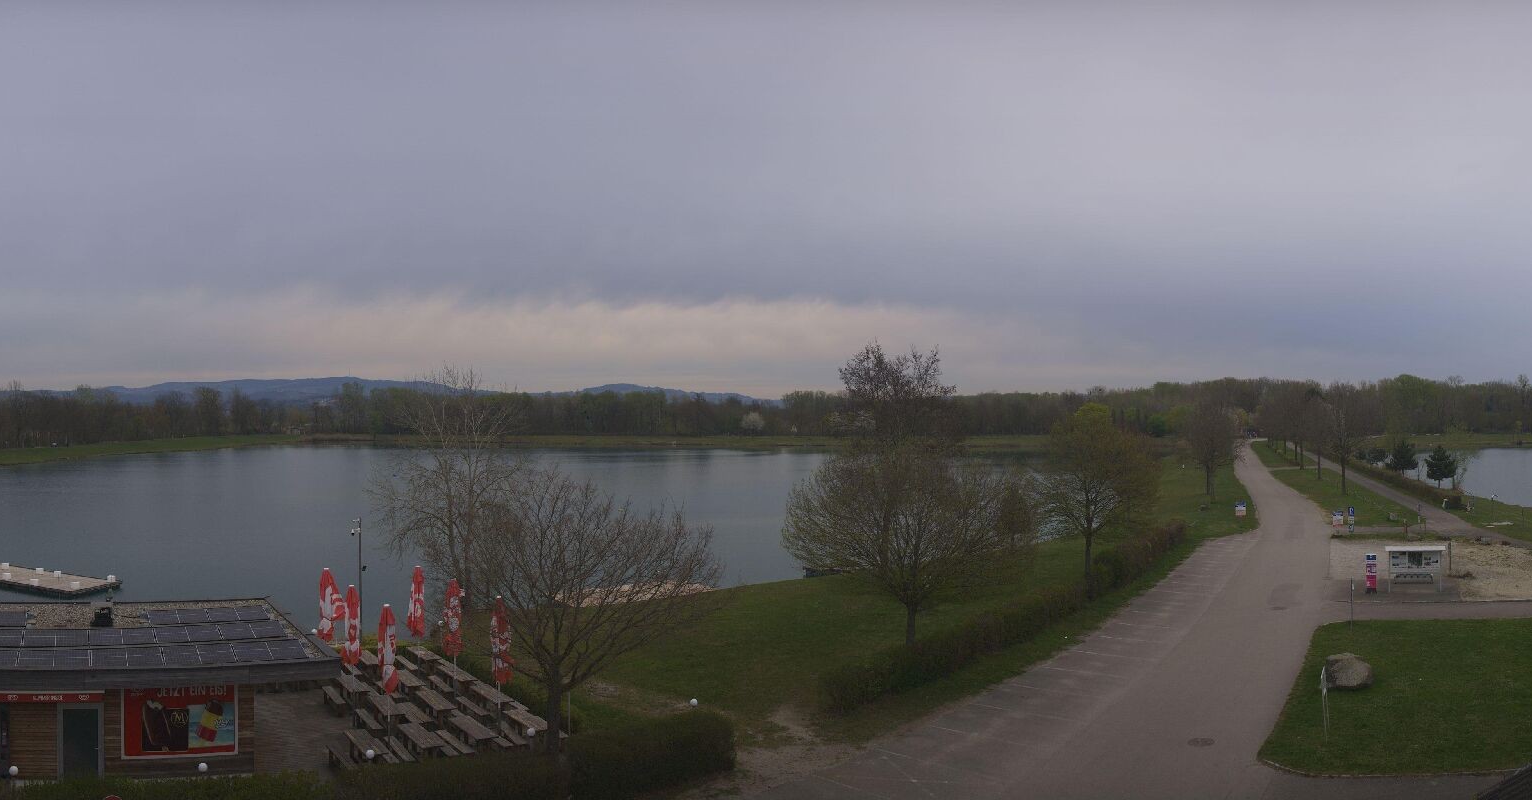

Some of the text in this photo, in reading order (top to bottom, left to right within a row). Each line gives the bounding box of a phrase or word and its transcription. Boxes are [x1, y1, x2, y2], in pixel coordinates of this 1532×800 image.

[156, 687, 185, 697] JETZT
[189, 685, 206, 696] EIN
[210, 684, 227, 696] EIS!
